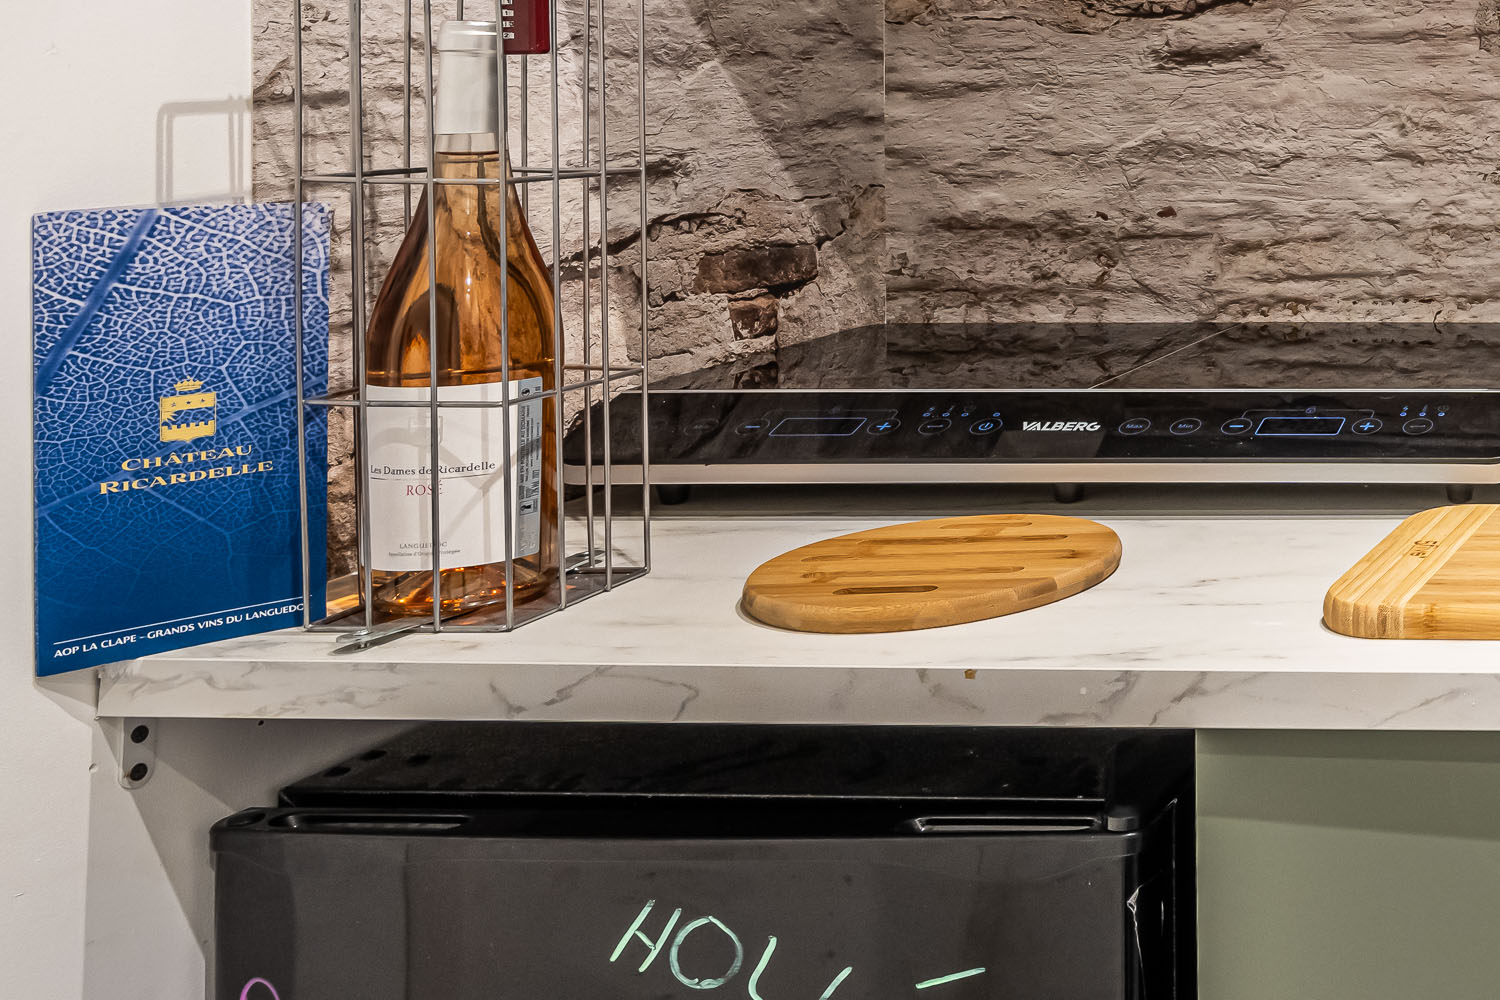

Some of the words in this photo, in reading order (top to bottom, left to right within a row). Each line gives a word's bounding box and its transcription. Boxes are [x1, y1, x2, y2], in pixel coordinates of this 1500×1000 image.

[1022, 421, 1101, 432] VALBERG
[121, 444, 252, 471] CHÂTEAU
[370, 465, 382, 475] Les
[384, 466, 416, 476] Dames
[99, 460, 274, 495] RICARDELLE
[54, 645, 80, 658] AOP
[82, 642, 98, 652] LA
[100, 634, 137, 648] CLAPE
[147, 622, 196, 640] GRANDS
[198, 616, 224, 630] VINS
[226, 612, 243, 624] DU
